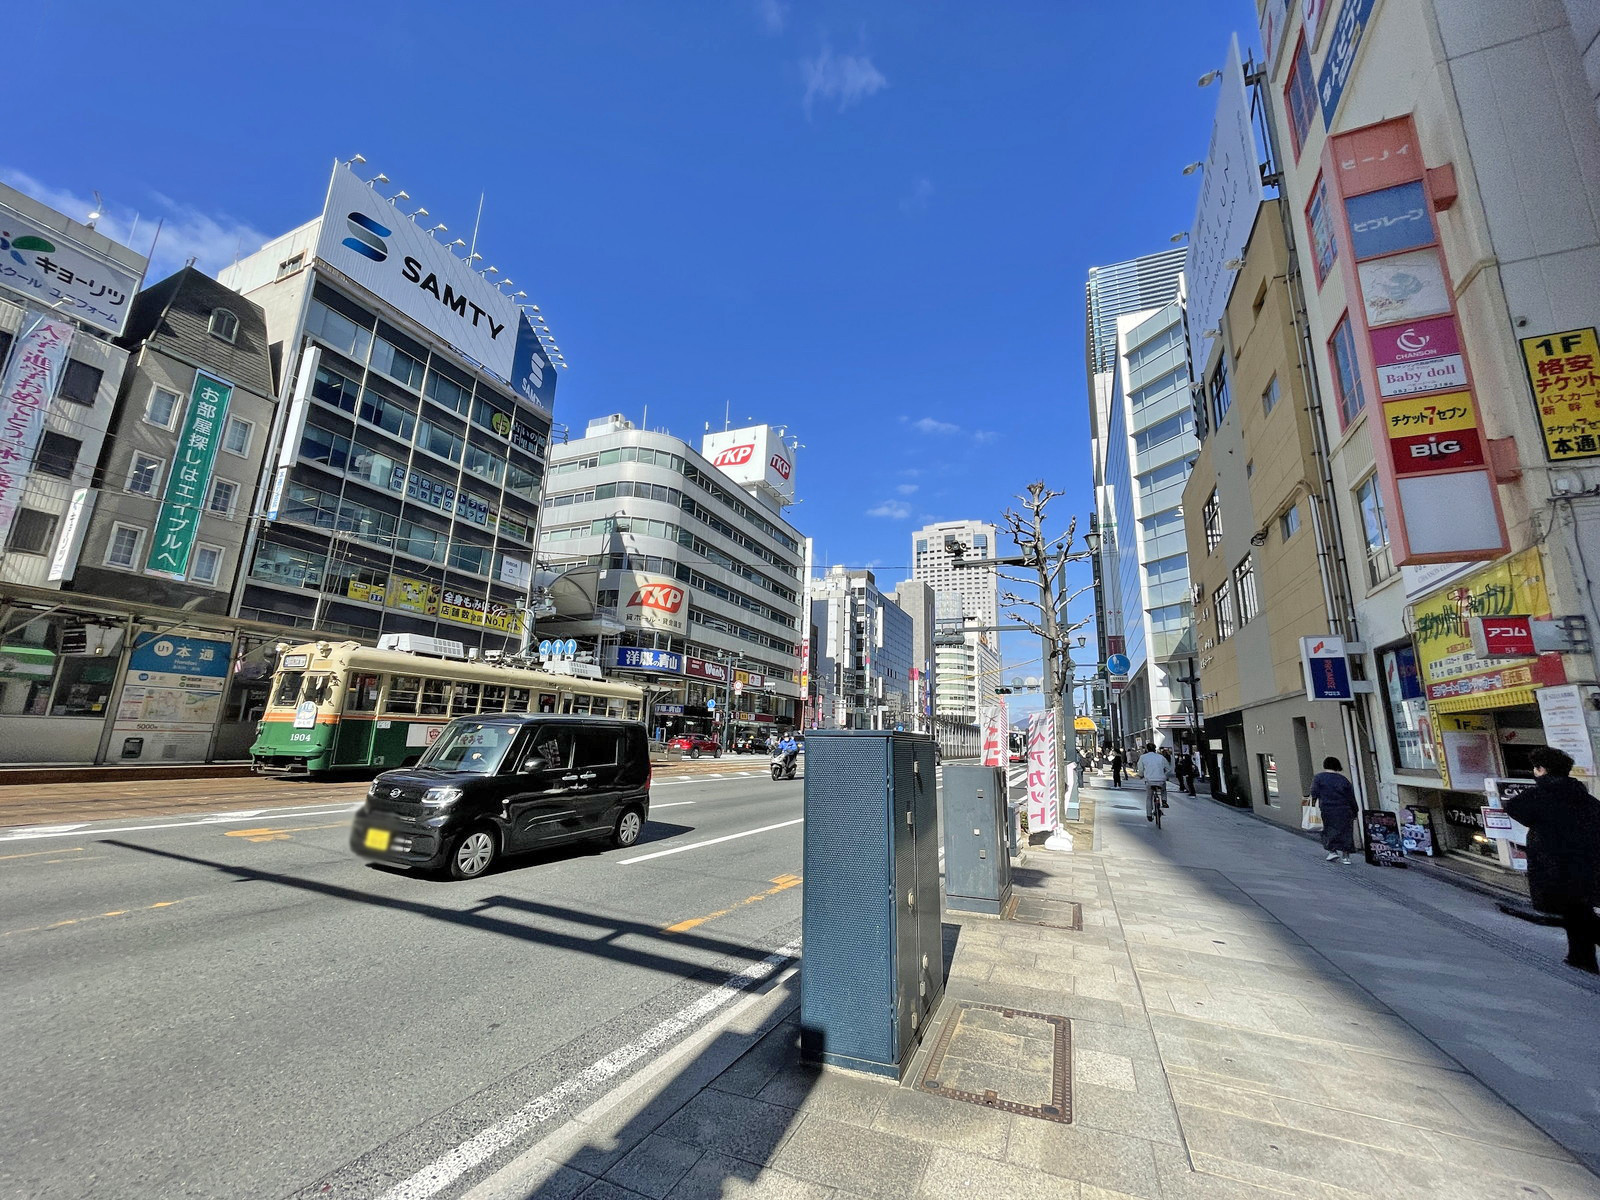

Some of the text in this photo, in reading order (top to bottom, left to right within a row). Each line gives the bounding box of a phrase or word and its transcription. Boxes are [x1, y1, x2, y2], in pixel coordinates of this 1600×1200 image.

[0, 263, 42, 288] クール
[35, 256, 125, 306] キョーリツ
[401, 256, 505, 341] SAMTY
[1395, 348, 1437, 361] CHANSON
[1536, 334, 1581, 356] 1F
[1386, 371, 1422, 384] Baby
[1427, 364, 1456, 378] doll
[1537, 354, 1594, 377] 格安
[521, 376, 544, 408] SAMT
[1391, 406, 1468, 427] チケット7セブン
[1547, 418, 1600, 436] チケット7セ
[1552, 433, 1600, 455] 本通
[714, 446, 752, 466] TKP
[771, 454, 790, 476] TKP
[157, 386, 220, 567] お部屋探しはエイブルへ
[394, 466, 488, 514] 家庭教師のトライ
[636, 583, 683, 608] TKP
[626, 612, 683, 630] 貸ホール・貸会議室
[1487, 627, 1528, 637] アコム
[626, 651, 678, 671] 洋服の青山
[1454, 719, 1472, 731] 1F
[289, 733, 312, 742] 1904
